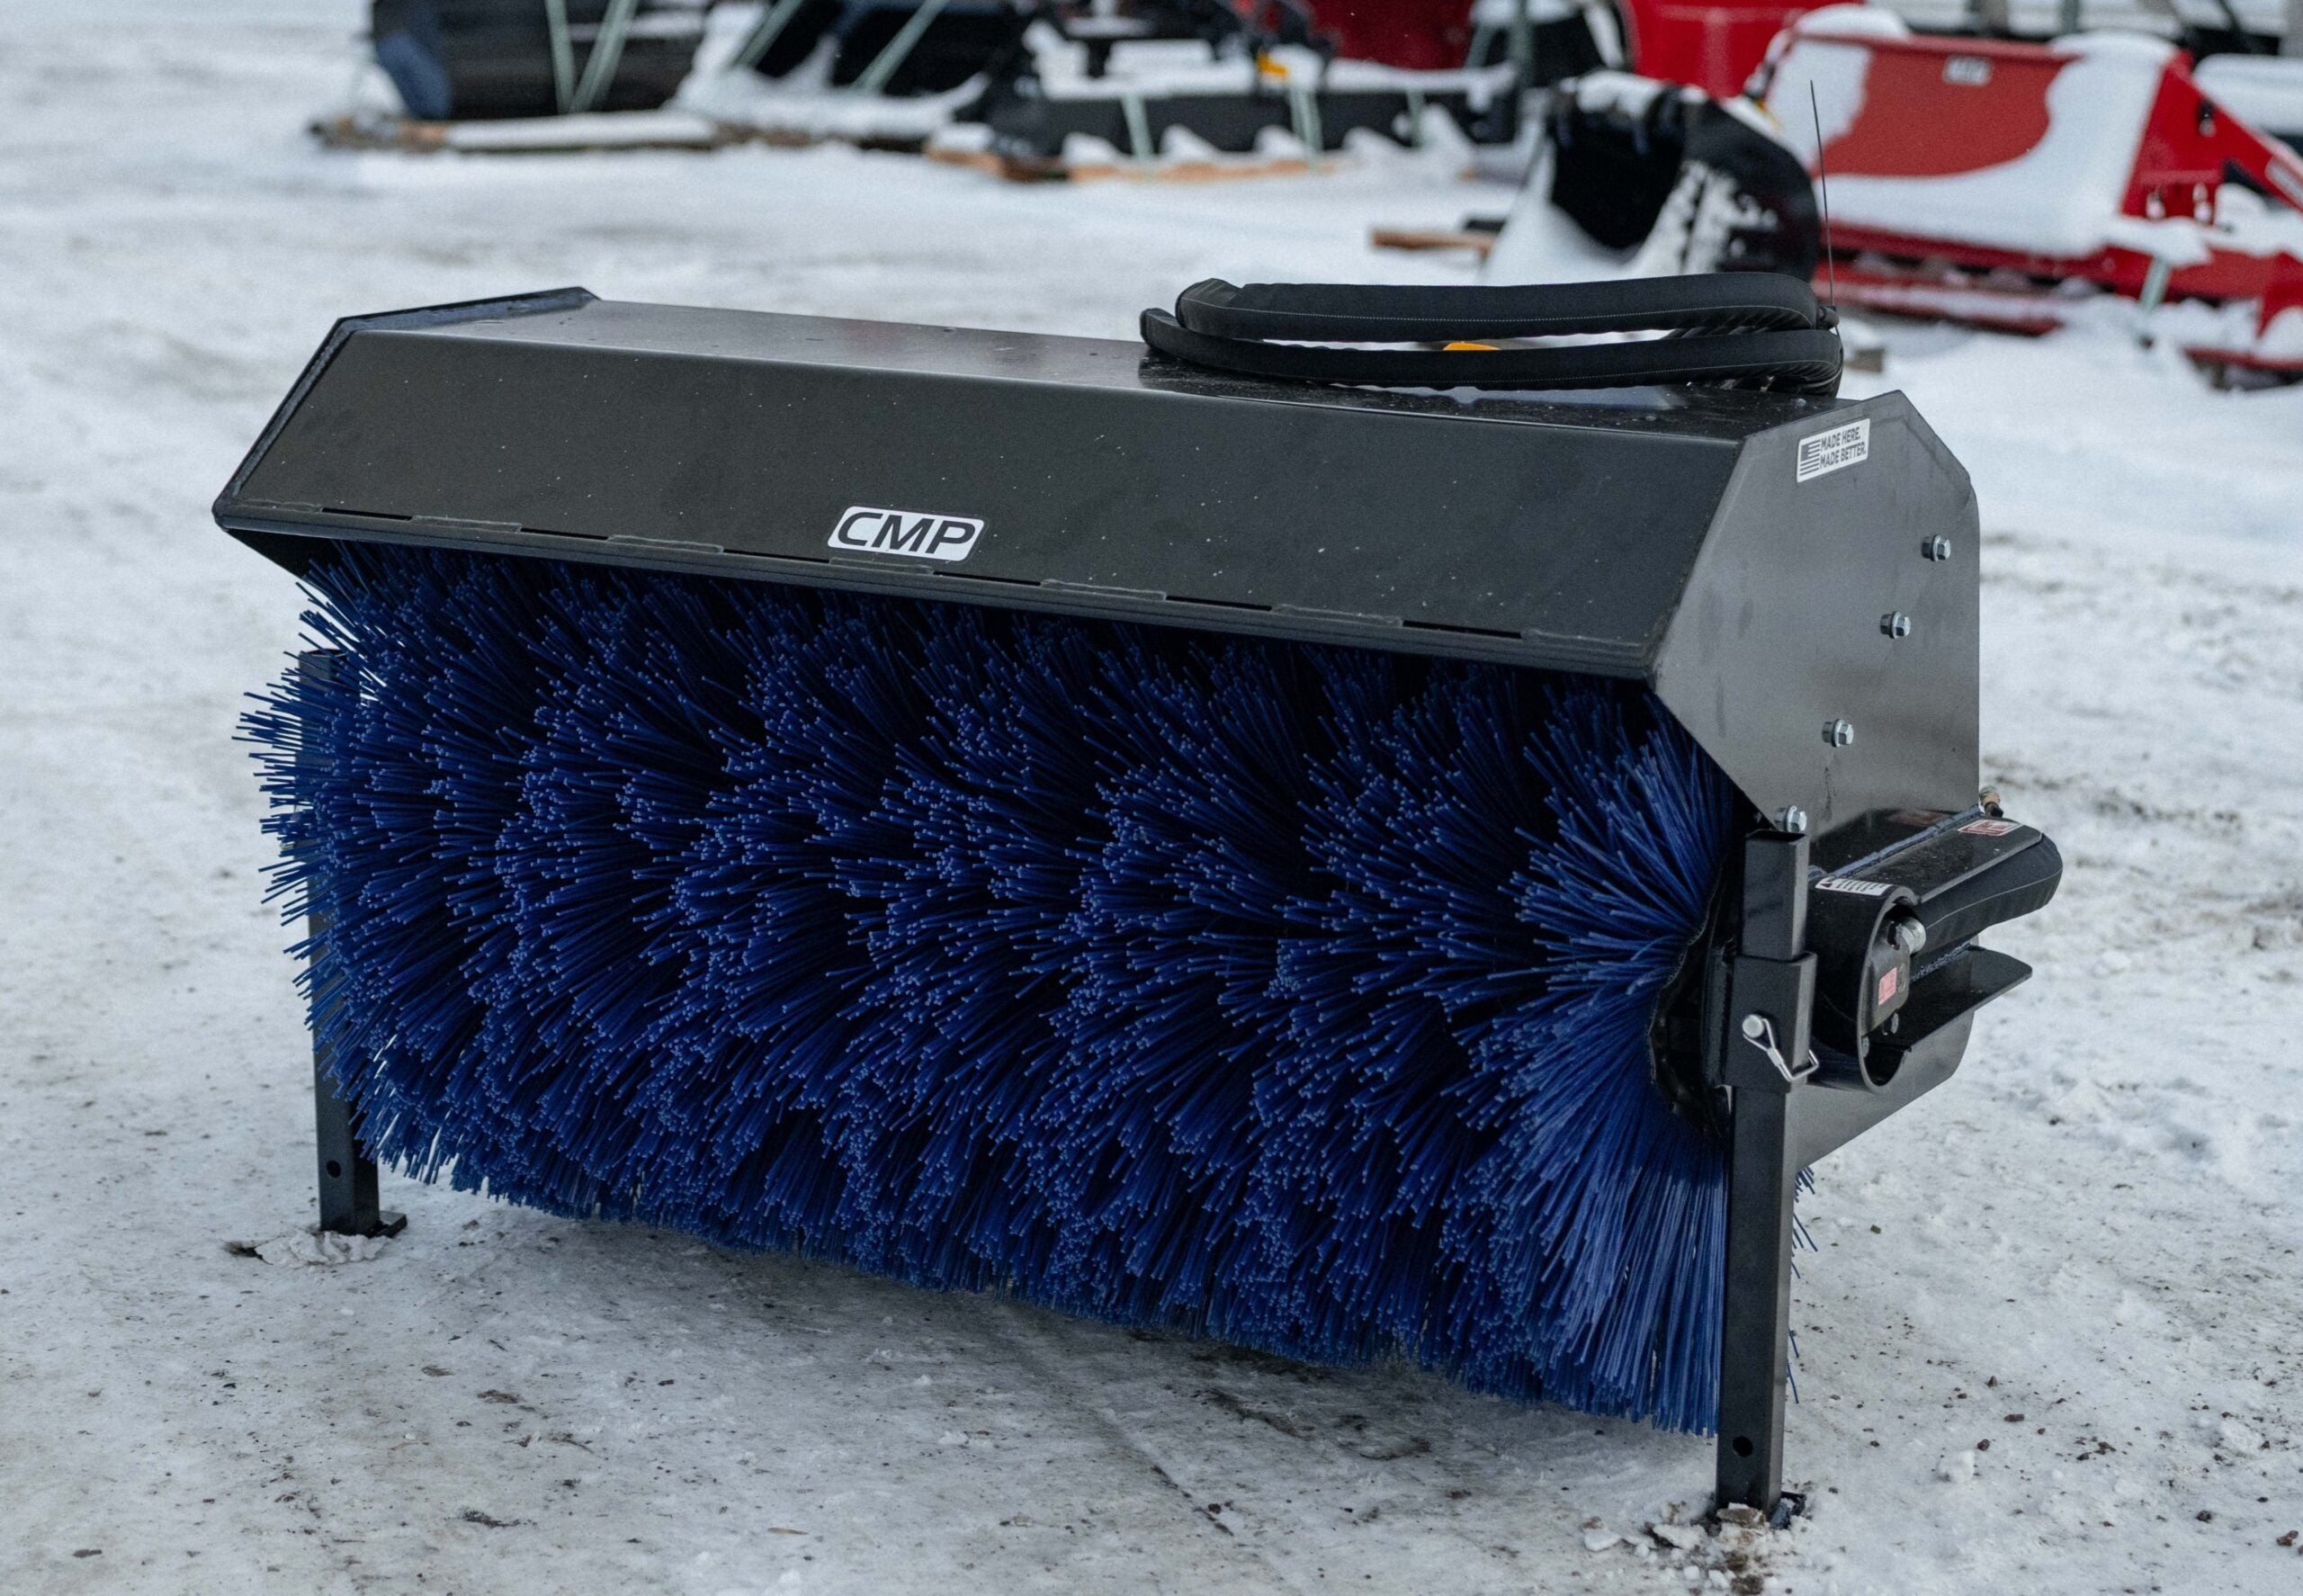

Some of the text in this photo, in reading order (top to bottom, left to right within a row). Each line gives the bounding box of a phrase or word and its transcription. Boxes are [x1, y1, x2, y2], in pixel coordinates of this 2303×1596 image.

[1820, 426, 1861, 451] MADE HERE.
[1819, 441, 1867, 469] MADE BETTER.
[838, 511, 976, 554] CMP
